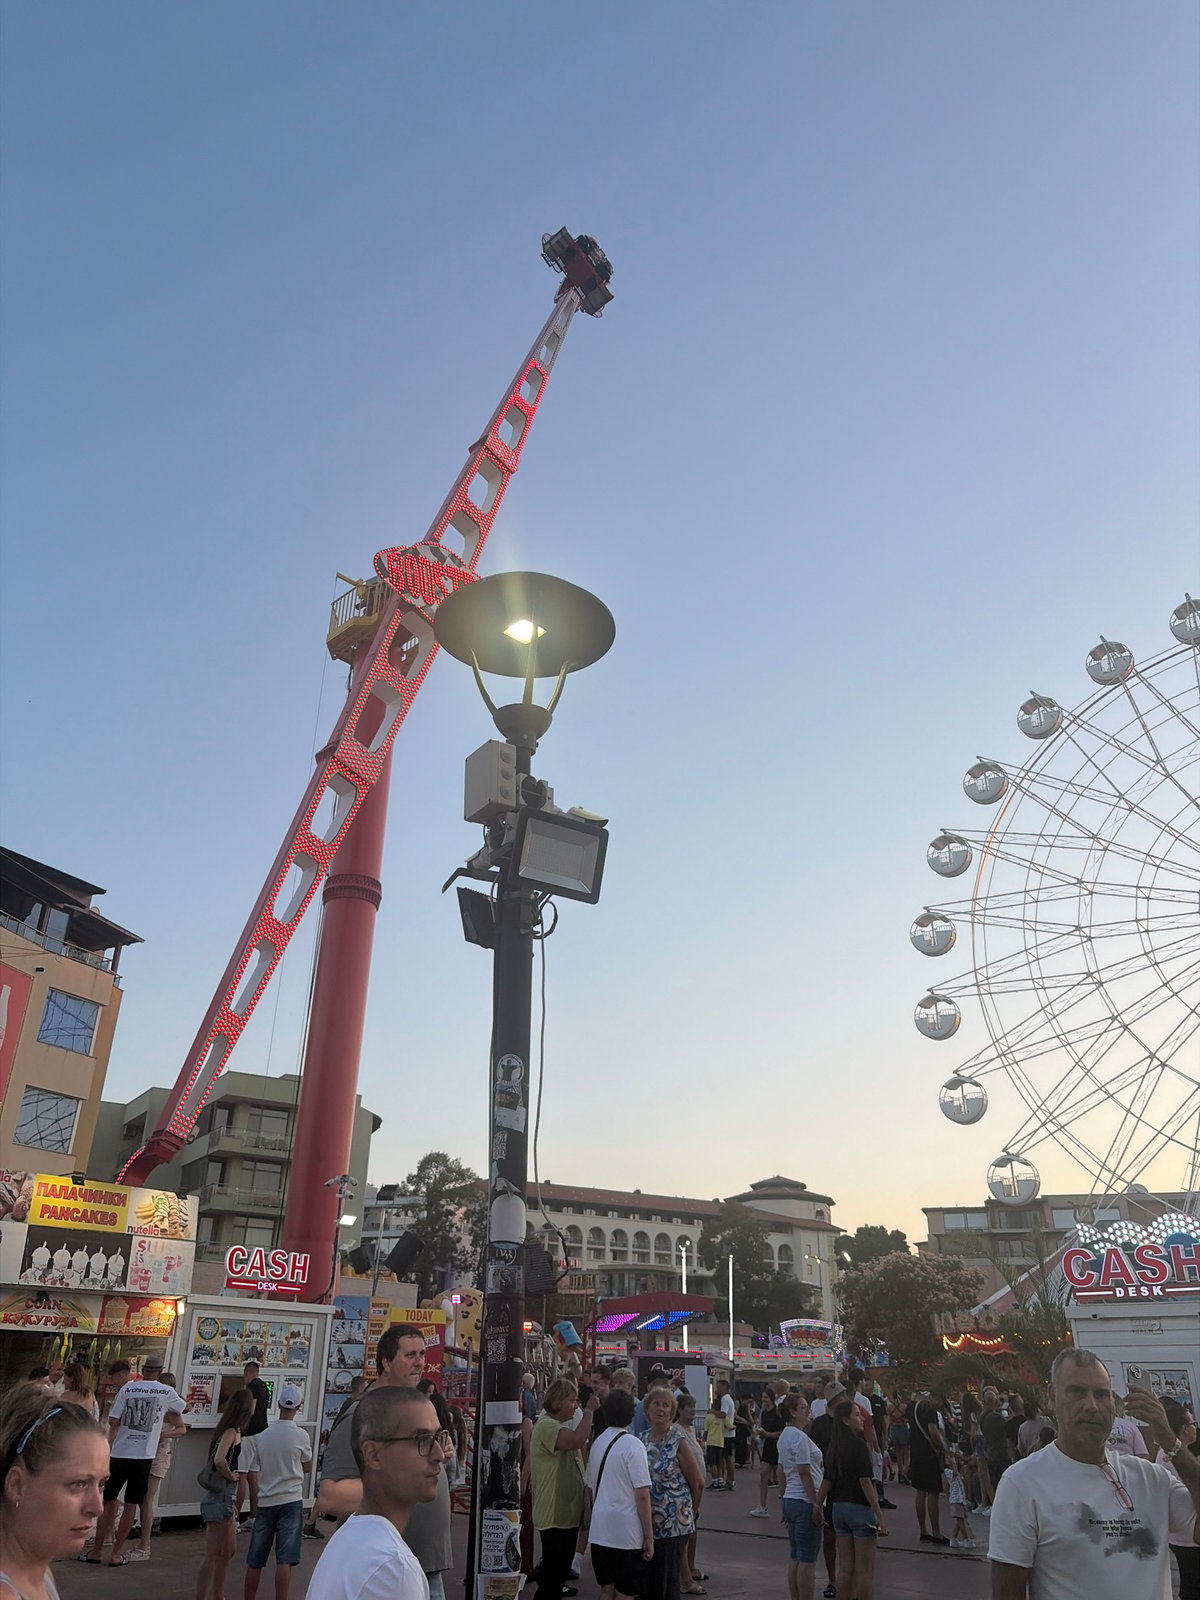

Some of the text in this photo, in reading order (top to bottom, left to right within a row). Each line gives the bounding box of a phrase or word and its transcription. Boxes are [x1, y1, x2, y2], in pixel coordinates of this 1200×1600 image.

[387, 551, 476, 605] BOOST
[36, 1182, 127, 1207] ПАЛАЧИНКИ
[39, 1203, 118, 1226] PANCAKES
[127, 1225, 160, 1236] nutella
[226, 1245, 310, 1283] CASH
[1061, 1243, 1200, 1287] CASH
[257, 1281, 278, 1291] DESK
[1115, 1286, 1164, 1297] DESK
[25, 1297, 63, 1310] CORN
[2, 1313, 79, 1327] КУКУРУЗА
[405, 1309, 434, 1321] TODAY
[135, 1326, 168, 1335] POPCORN
